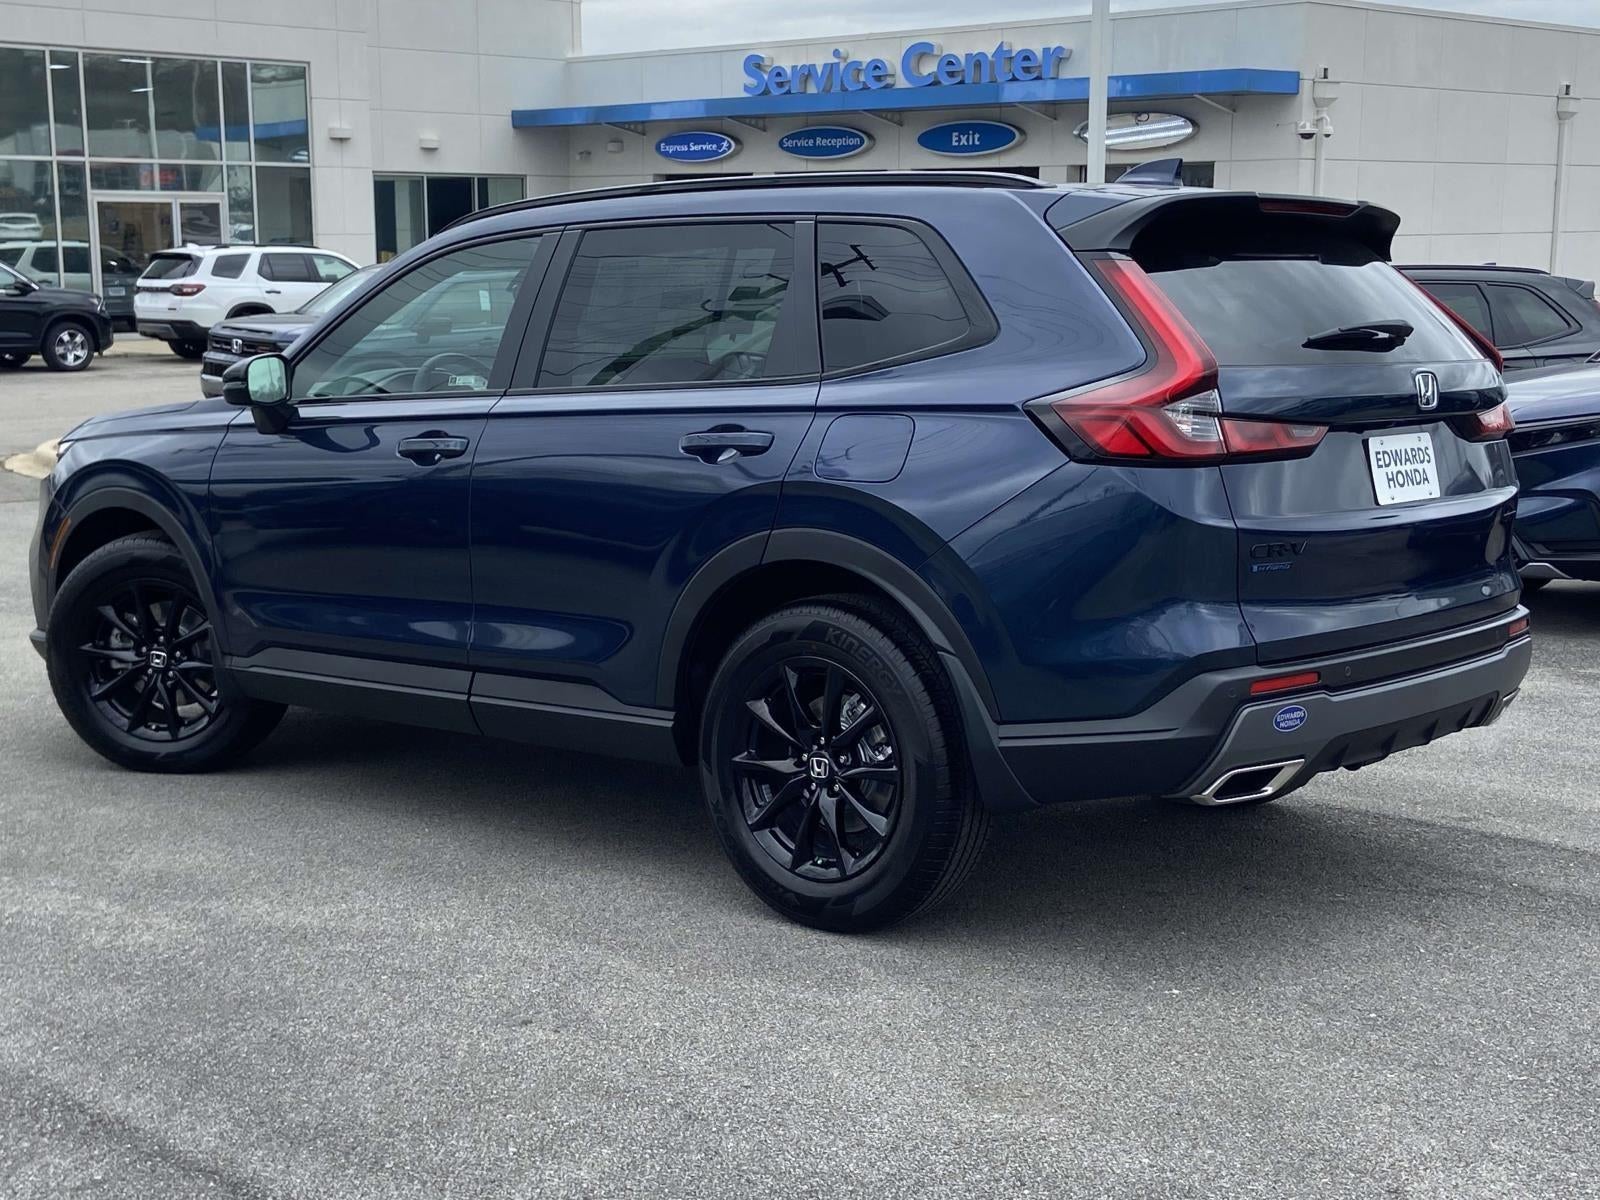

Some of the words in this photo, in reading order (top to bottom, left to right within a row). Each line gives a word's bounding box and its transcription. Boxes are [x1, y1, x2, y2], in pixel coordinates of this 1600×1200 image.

[743, 48, 892, 96] Service
[901, 40, 1069, 87] Center
[783, 137, 814, 148] Service
[815, 136, 860, 149] Reception
[951, 130, 981, 146] Exit
[660, 142, 688, 154] Express
[689, 142, 718, 151] Service
[1374, 446, 1432, 469] EDWARDS
[1385, 467, 1430, 489] HONDA
[1276, 711, 1305, 722] EDWARDS
[1279, 718, 1301, 729] HONDA
